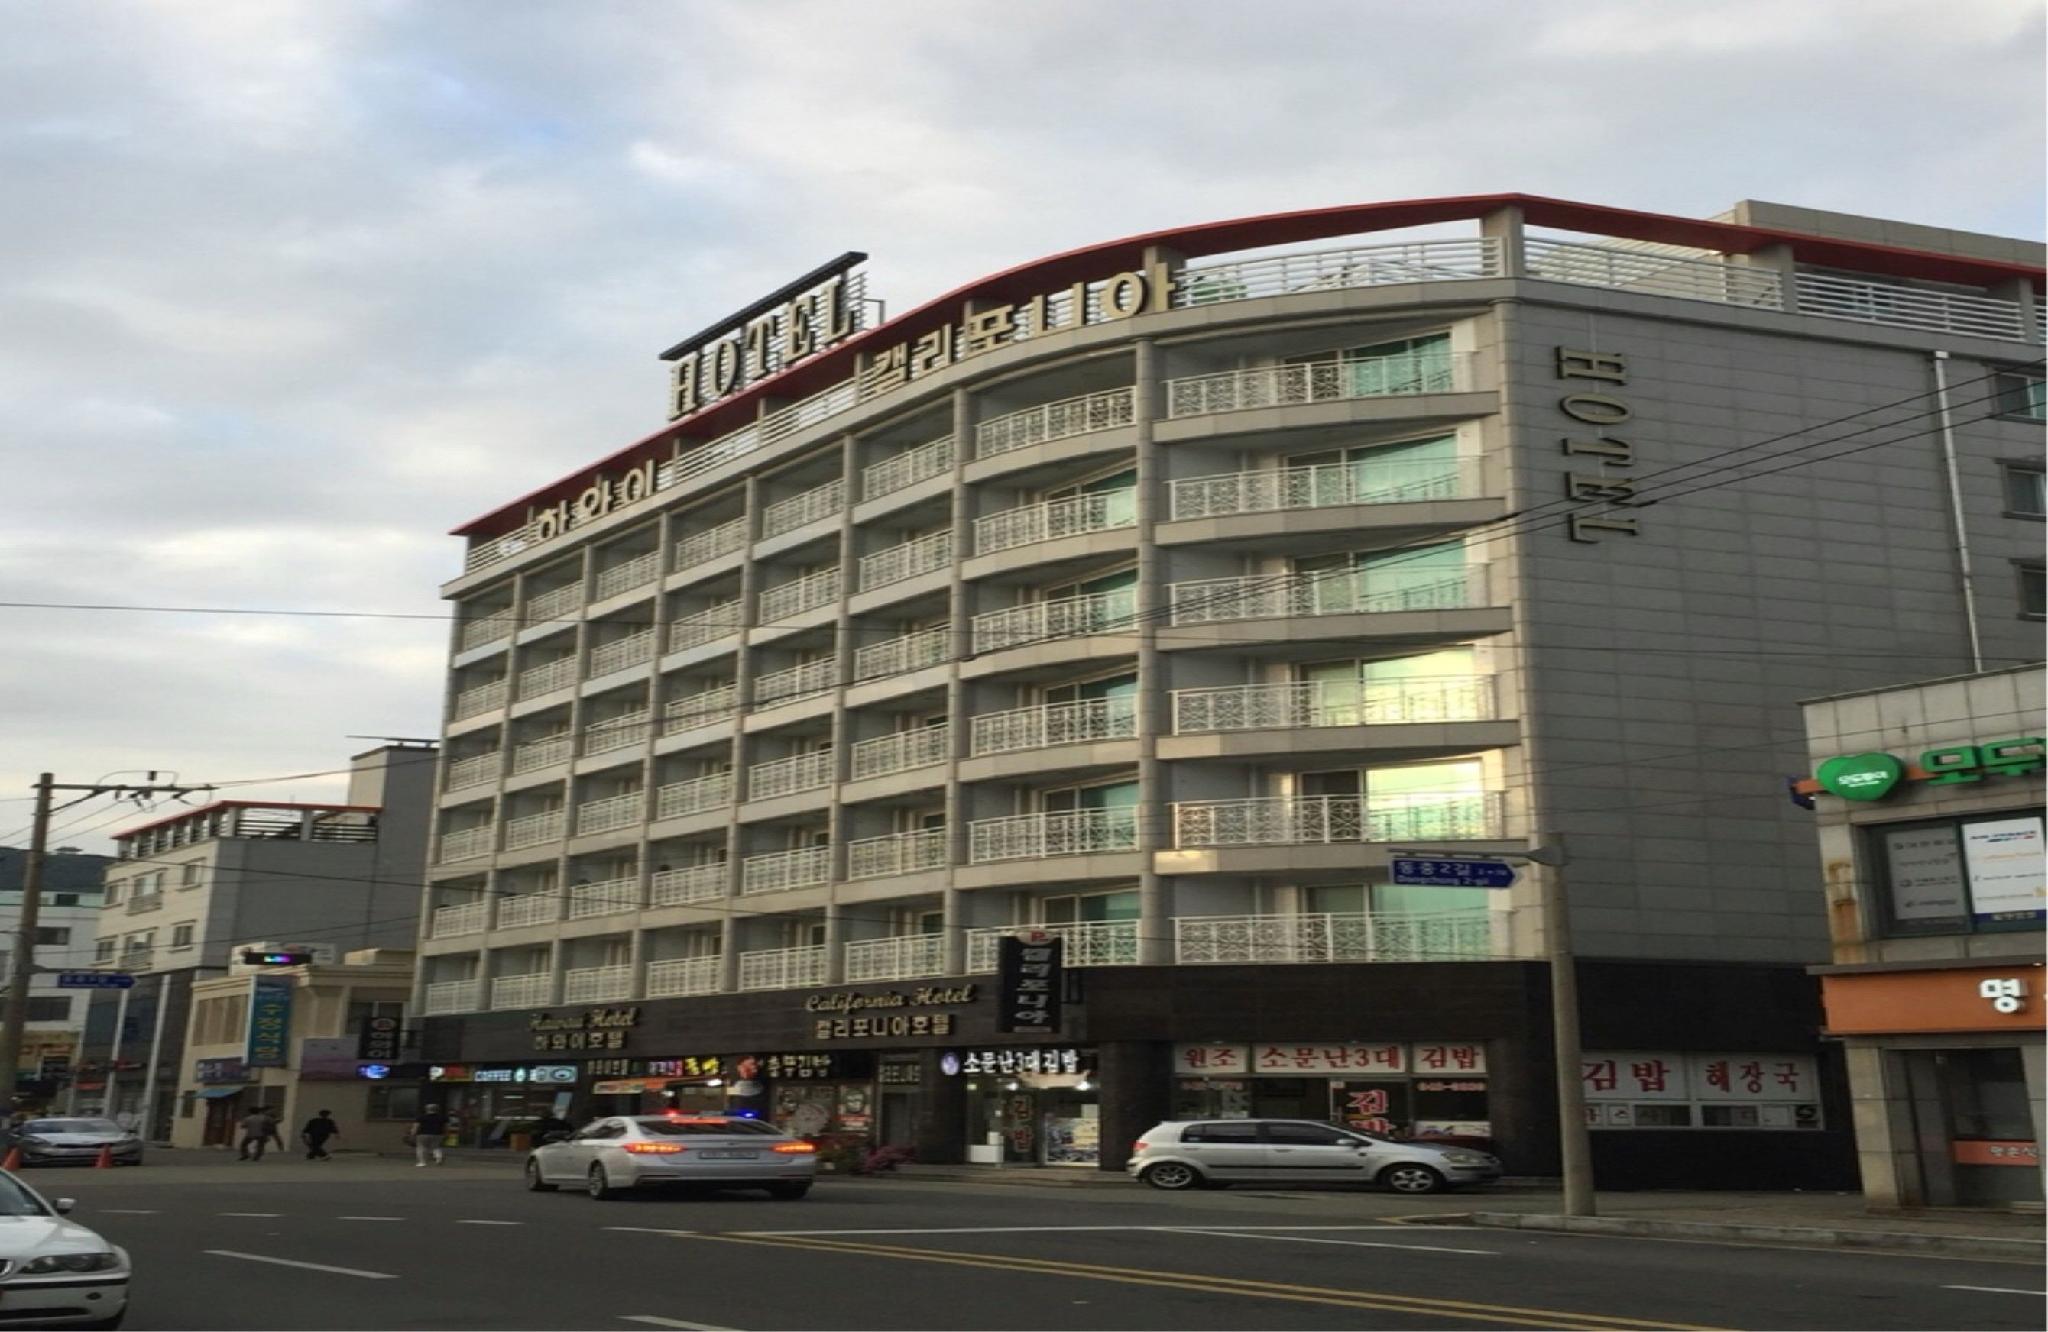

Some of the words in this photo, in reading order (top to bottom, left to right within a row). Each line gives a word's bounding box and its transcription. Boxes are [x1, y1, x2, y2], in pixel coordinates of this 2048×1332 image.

[870, 262, 1175, 397] 캘리포니아
[669, 279, 852, 421] HOTEL
[1555, 346, 1637, 544] HOTEL
[536, 459, 655, 539] 하와이
[805, 987, 904, 1014] California
[910, 983, 974, 1006] Hotel
[1980, 977, 2023, 1013] 명
[1043, 1049, 1079, 1074] 김밥
[1184, 1048, 1238, 1069] 원조
[1261, 1046, 1400, 1070] 소문난3대
[1420, 1046, 1480, 1070] 김밥
[1583, 1059, 1671, 1092] 김밥
[1705, 1060, 1799, 1094] 해장국
